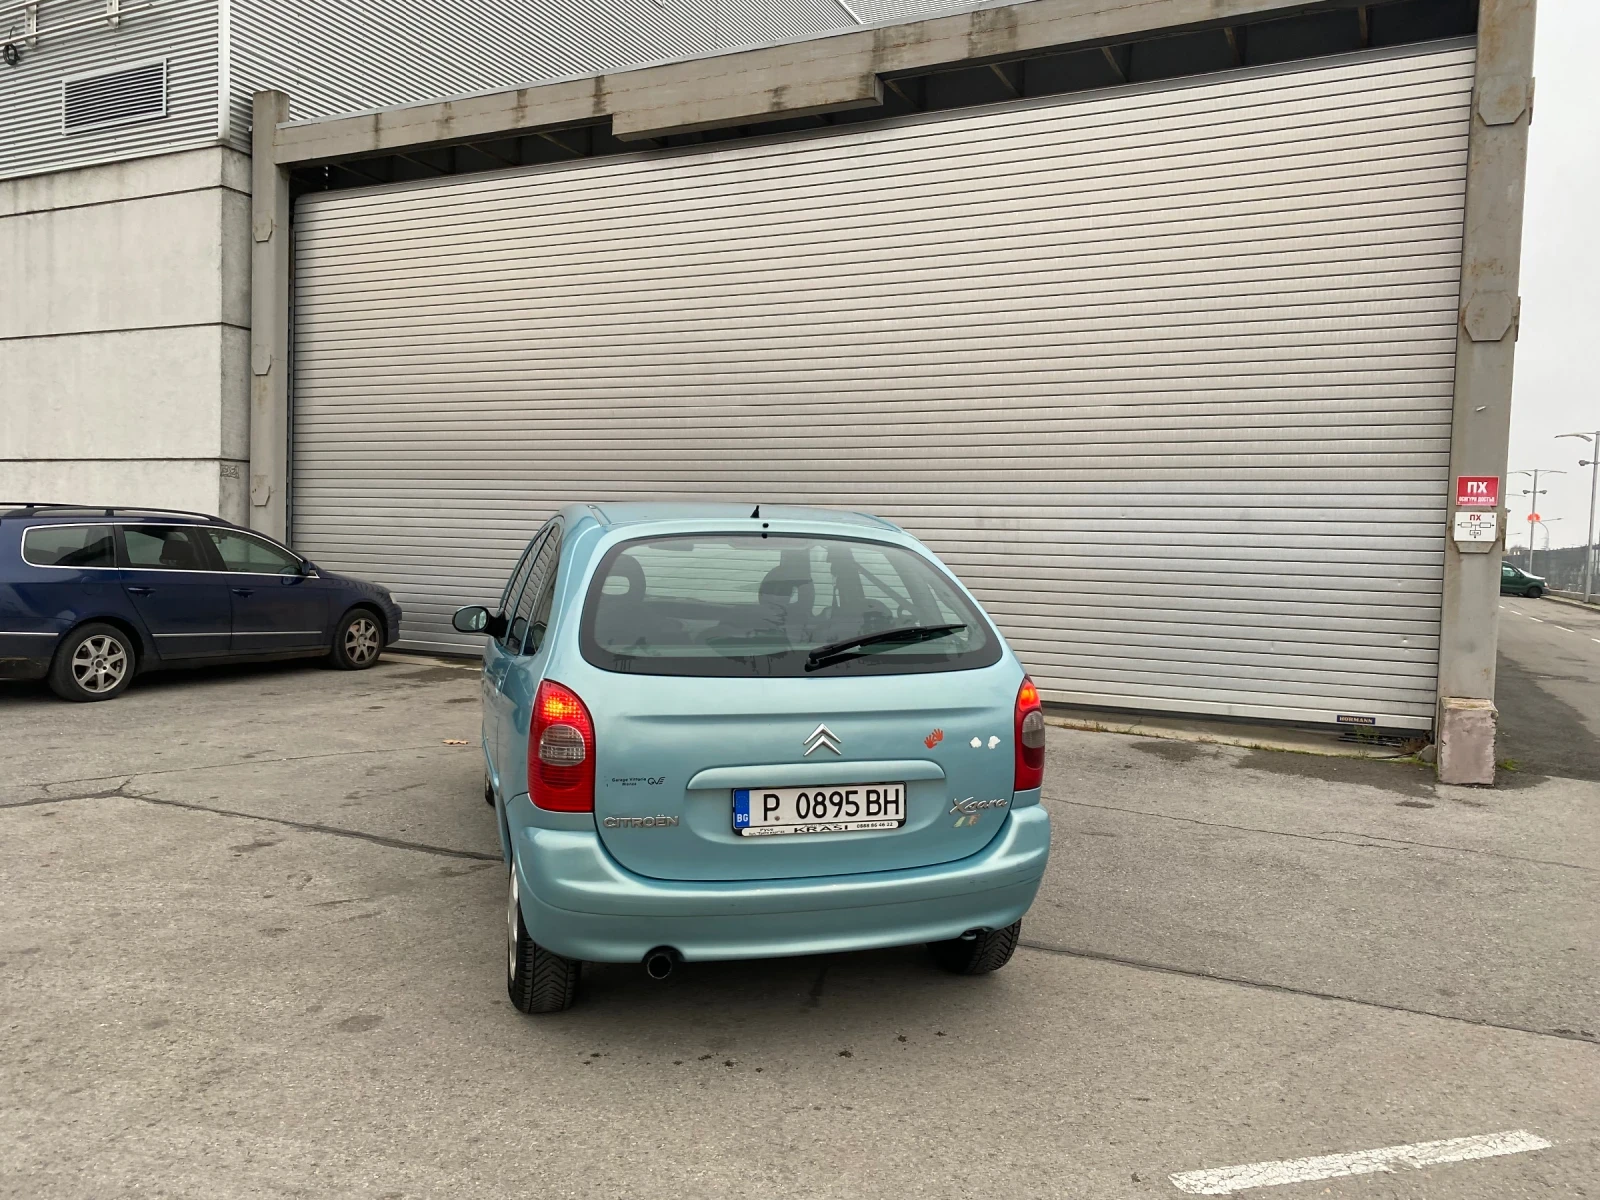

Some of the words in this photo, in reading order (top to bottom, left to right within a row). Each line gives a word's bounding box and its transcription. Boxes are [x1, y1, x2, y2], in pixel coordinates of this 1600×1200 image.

[1467, 481, 1488, 494] ПХ
[763, 793, 781, 822] P
[603, 814, 679, 828] CITROËN
[736, 813, 749, 823] BG
[794, 824, 848, 833] KRASI
